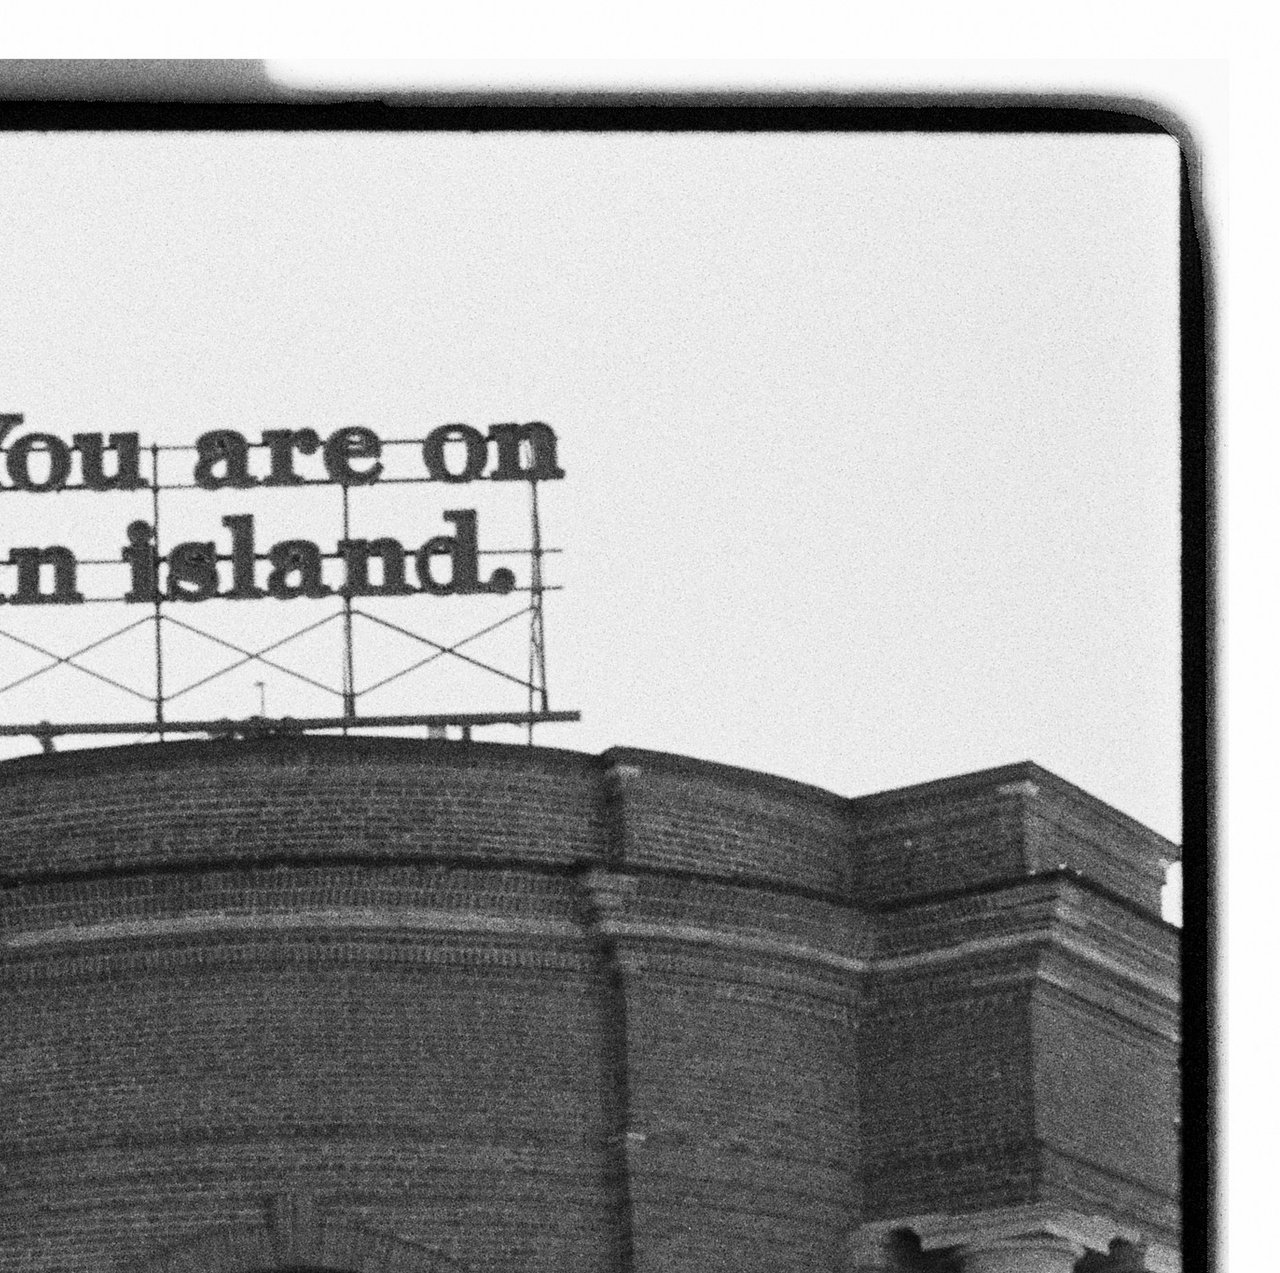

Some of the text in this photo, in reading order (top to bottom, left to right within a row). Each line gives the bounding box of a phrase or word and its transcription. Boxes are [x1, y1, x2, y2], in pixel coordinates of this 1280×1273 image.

[195, 425, 384, 488] are
[423, 422, 565, 481] on
[122, 509, 516, 603] island.
